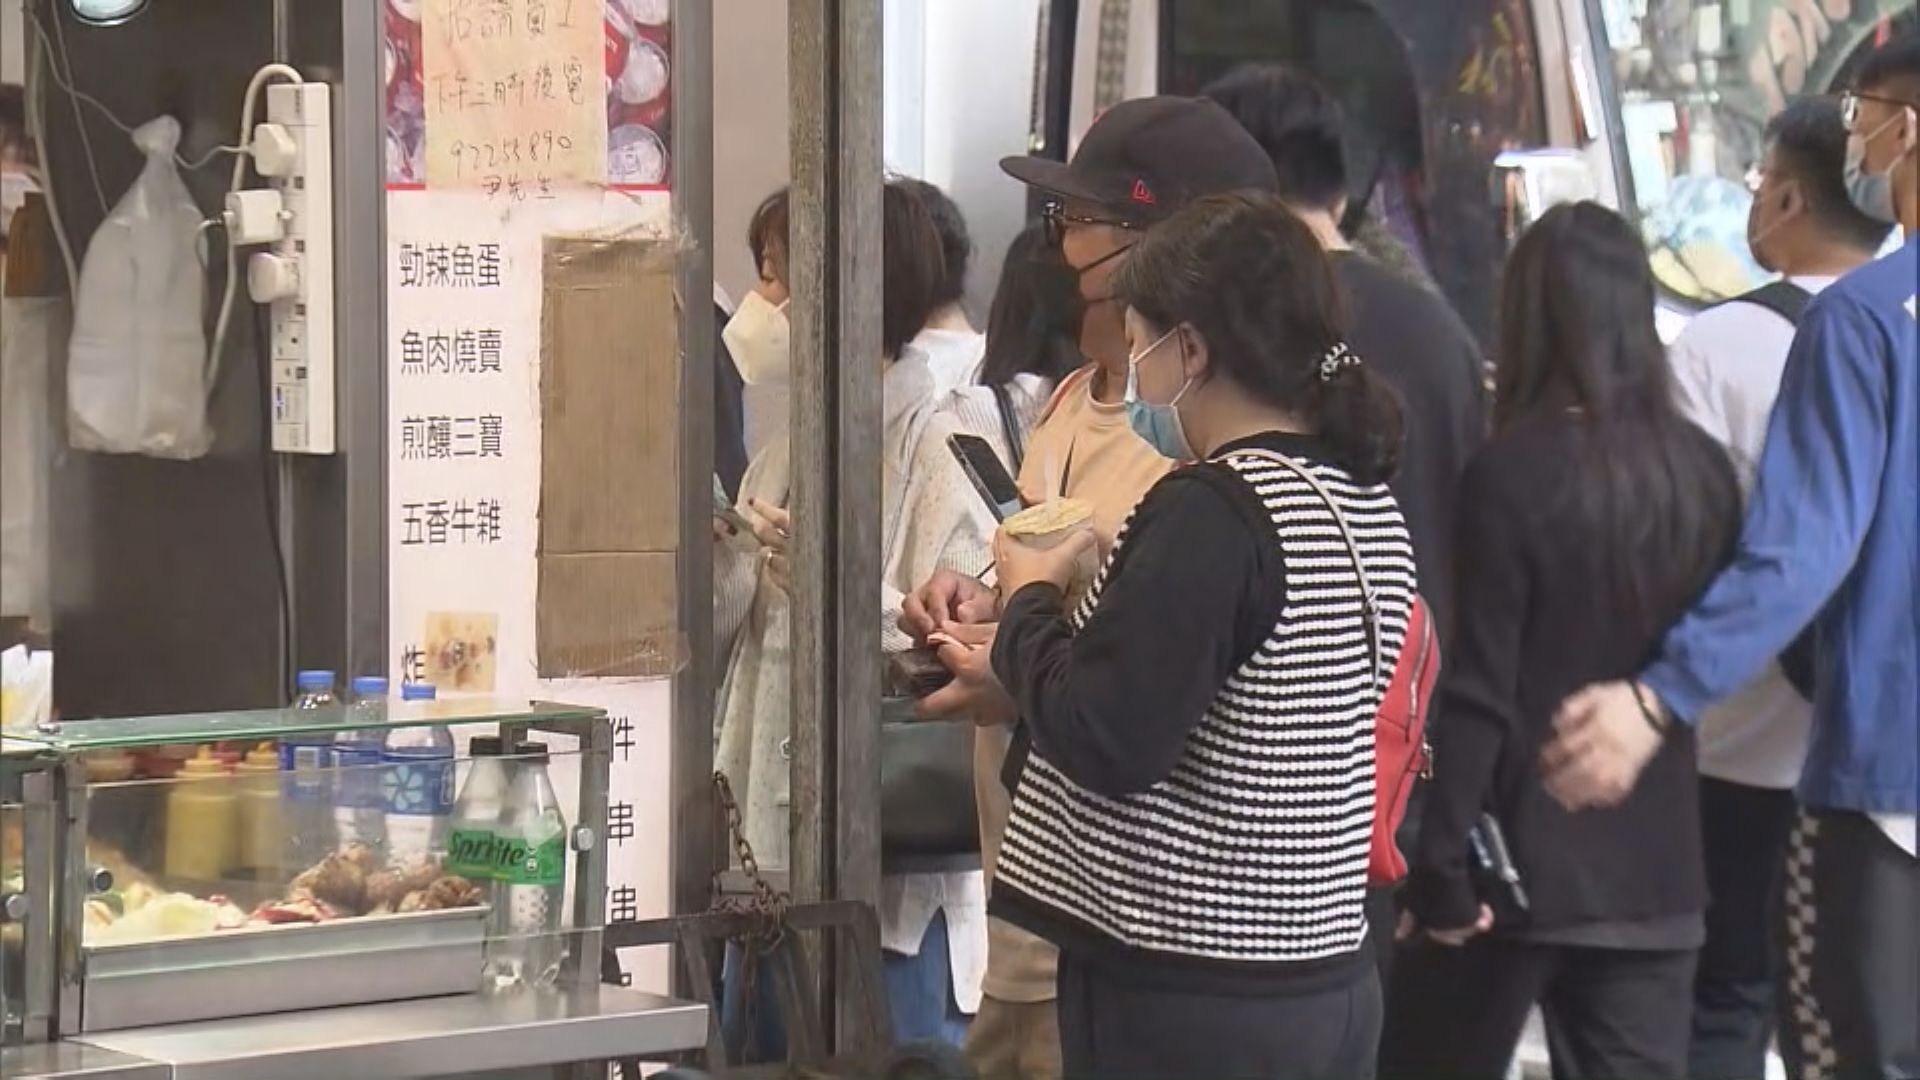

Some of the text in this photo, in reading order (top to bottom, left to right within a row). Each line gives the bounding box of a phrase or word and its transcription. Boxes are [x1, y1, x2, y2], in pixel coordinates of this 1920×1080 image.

[399, 243, 501, 287] 勁辣魚蛋
[400, 328, 503, 375] 魚肉燒賣
[400, 413, 503, 460] 煎釀三寶
[400, 497, 502, 545] 五香牛雜
[608, 800, 634, 847] 串
